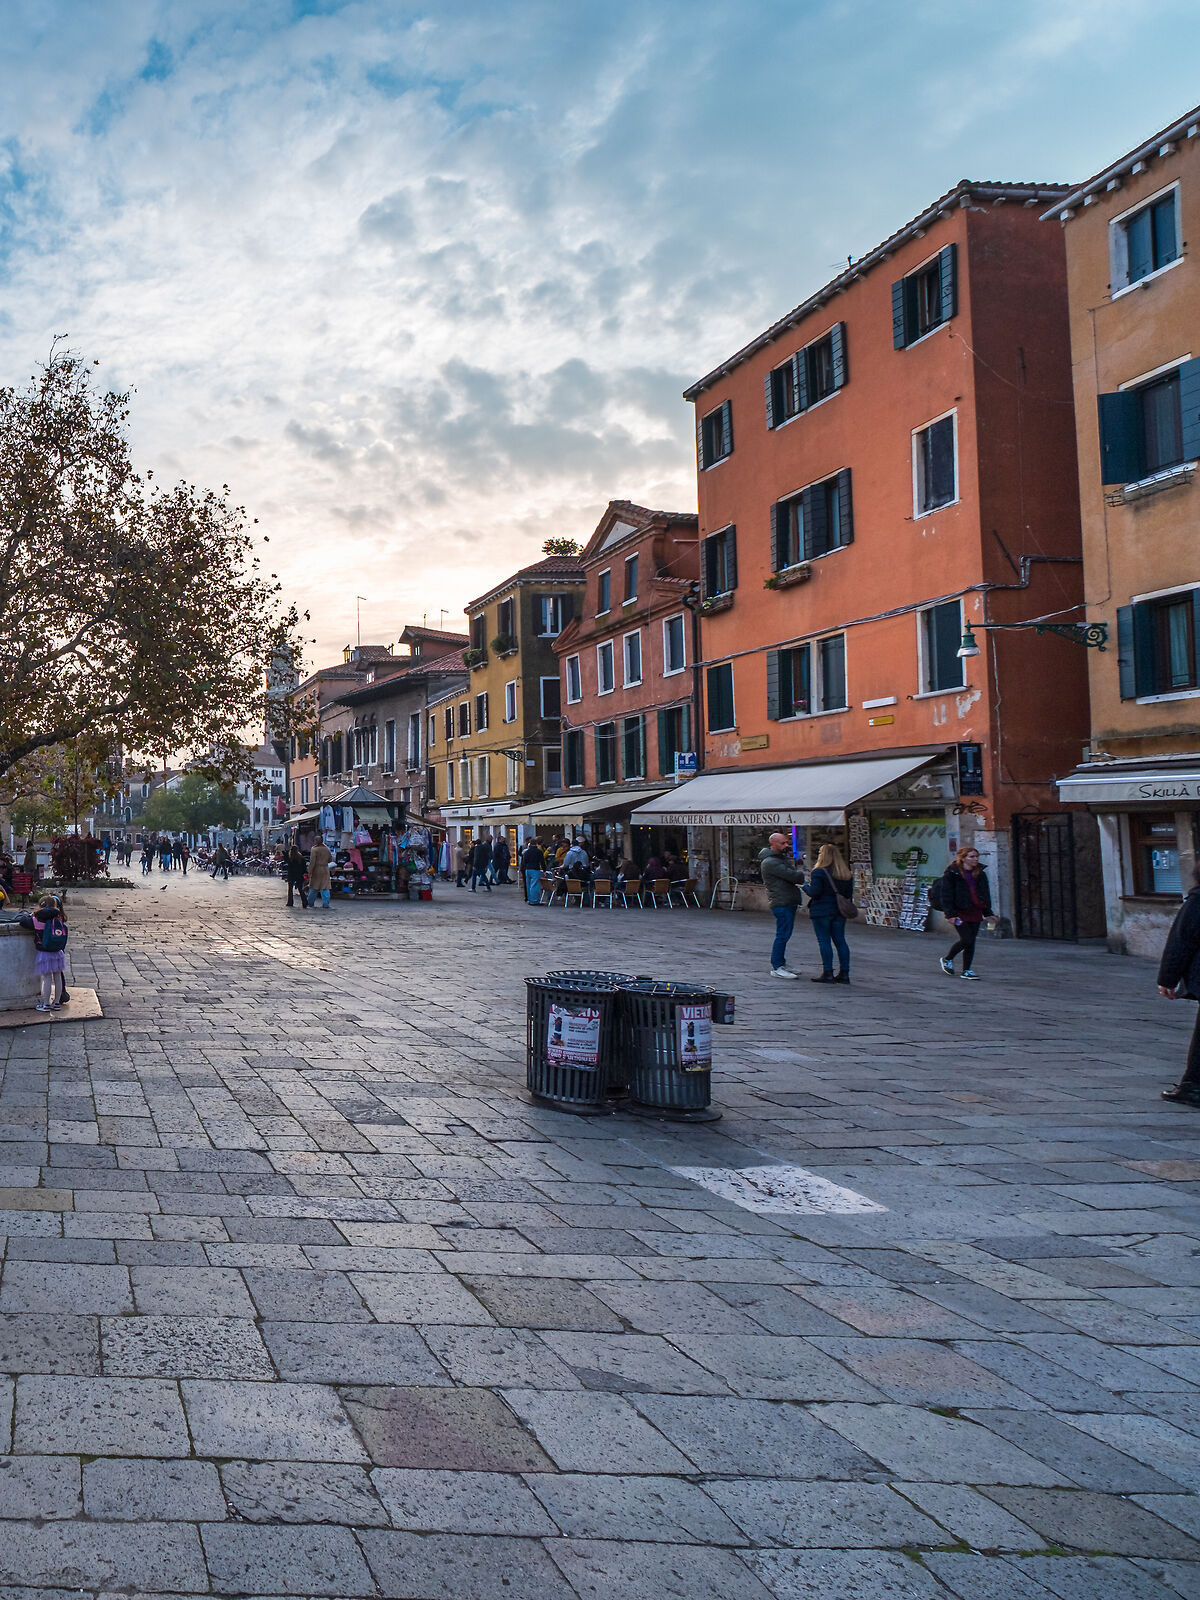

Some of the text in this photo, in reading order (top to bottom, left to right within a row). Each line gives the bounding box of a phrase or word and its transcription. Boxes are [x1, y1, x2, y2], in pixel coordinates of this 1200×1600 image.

[681, 753, 693, 764] T
[962, 747, 977, 773] T
[1139, 783, 1191, 798] SKILLÀ
[660, 813, 796, 825] TABACCHERIA GRANDESSO A.
